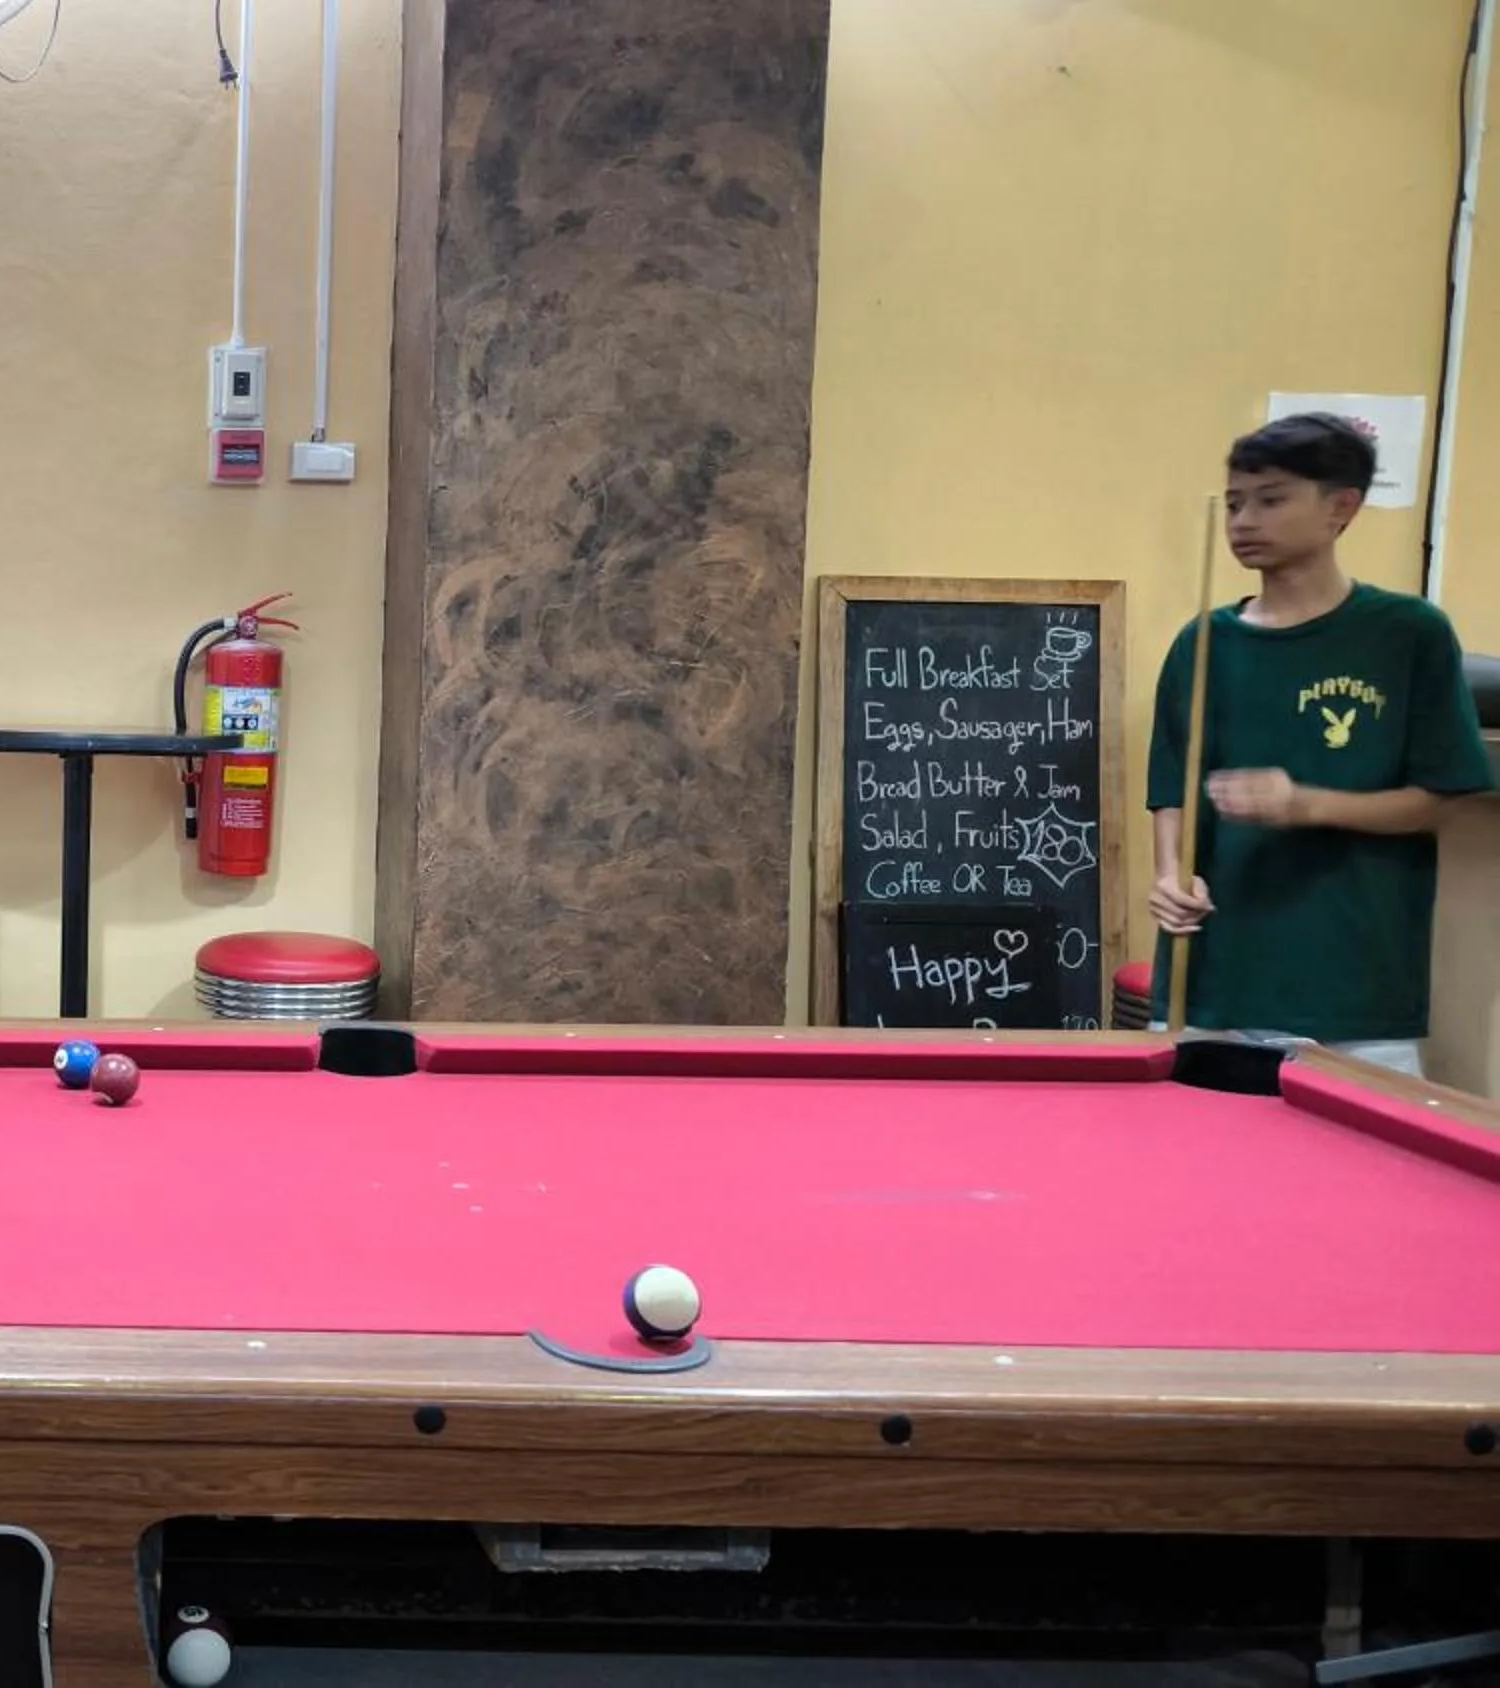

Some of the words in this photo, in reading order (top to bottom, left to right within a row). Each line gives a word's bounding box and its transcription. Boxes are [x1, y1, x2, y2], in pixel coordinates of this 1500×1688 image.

[866, 648, 908, 689] Full
[918, 645, 1021, 691] Breakfast
[1029, 655, 1075, 691] Set
[857, 760, 921, 802] Bread
[927, 760, 1007, 798] Butter
[1037, 764, 1081, 801] Jam
[955, 808, 1020, 849] Fruits
[1028, 819, 1085, 866] 180
[866, 860, 942, 898] Coffee
[952, 863, 987, 894] OR
[996, 865, 1033, 897] Tea
[887, 944, 1033, 1005] Happy
